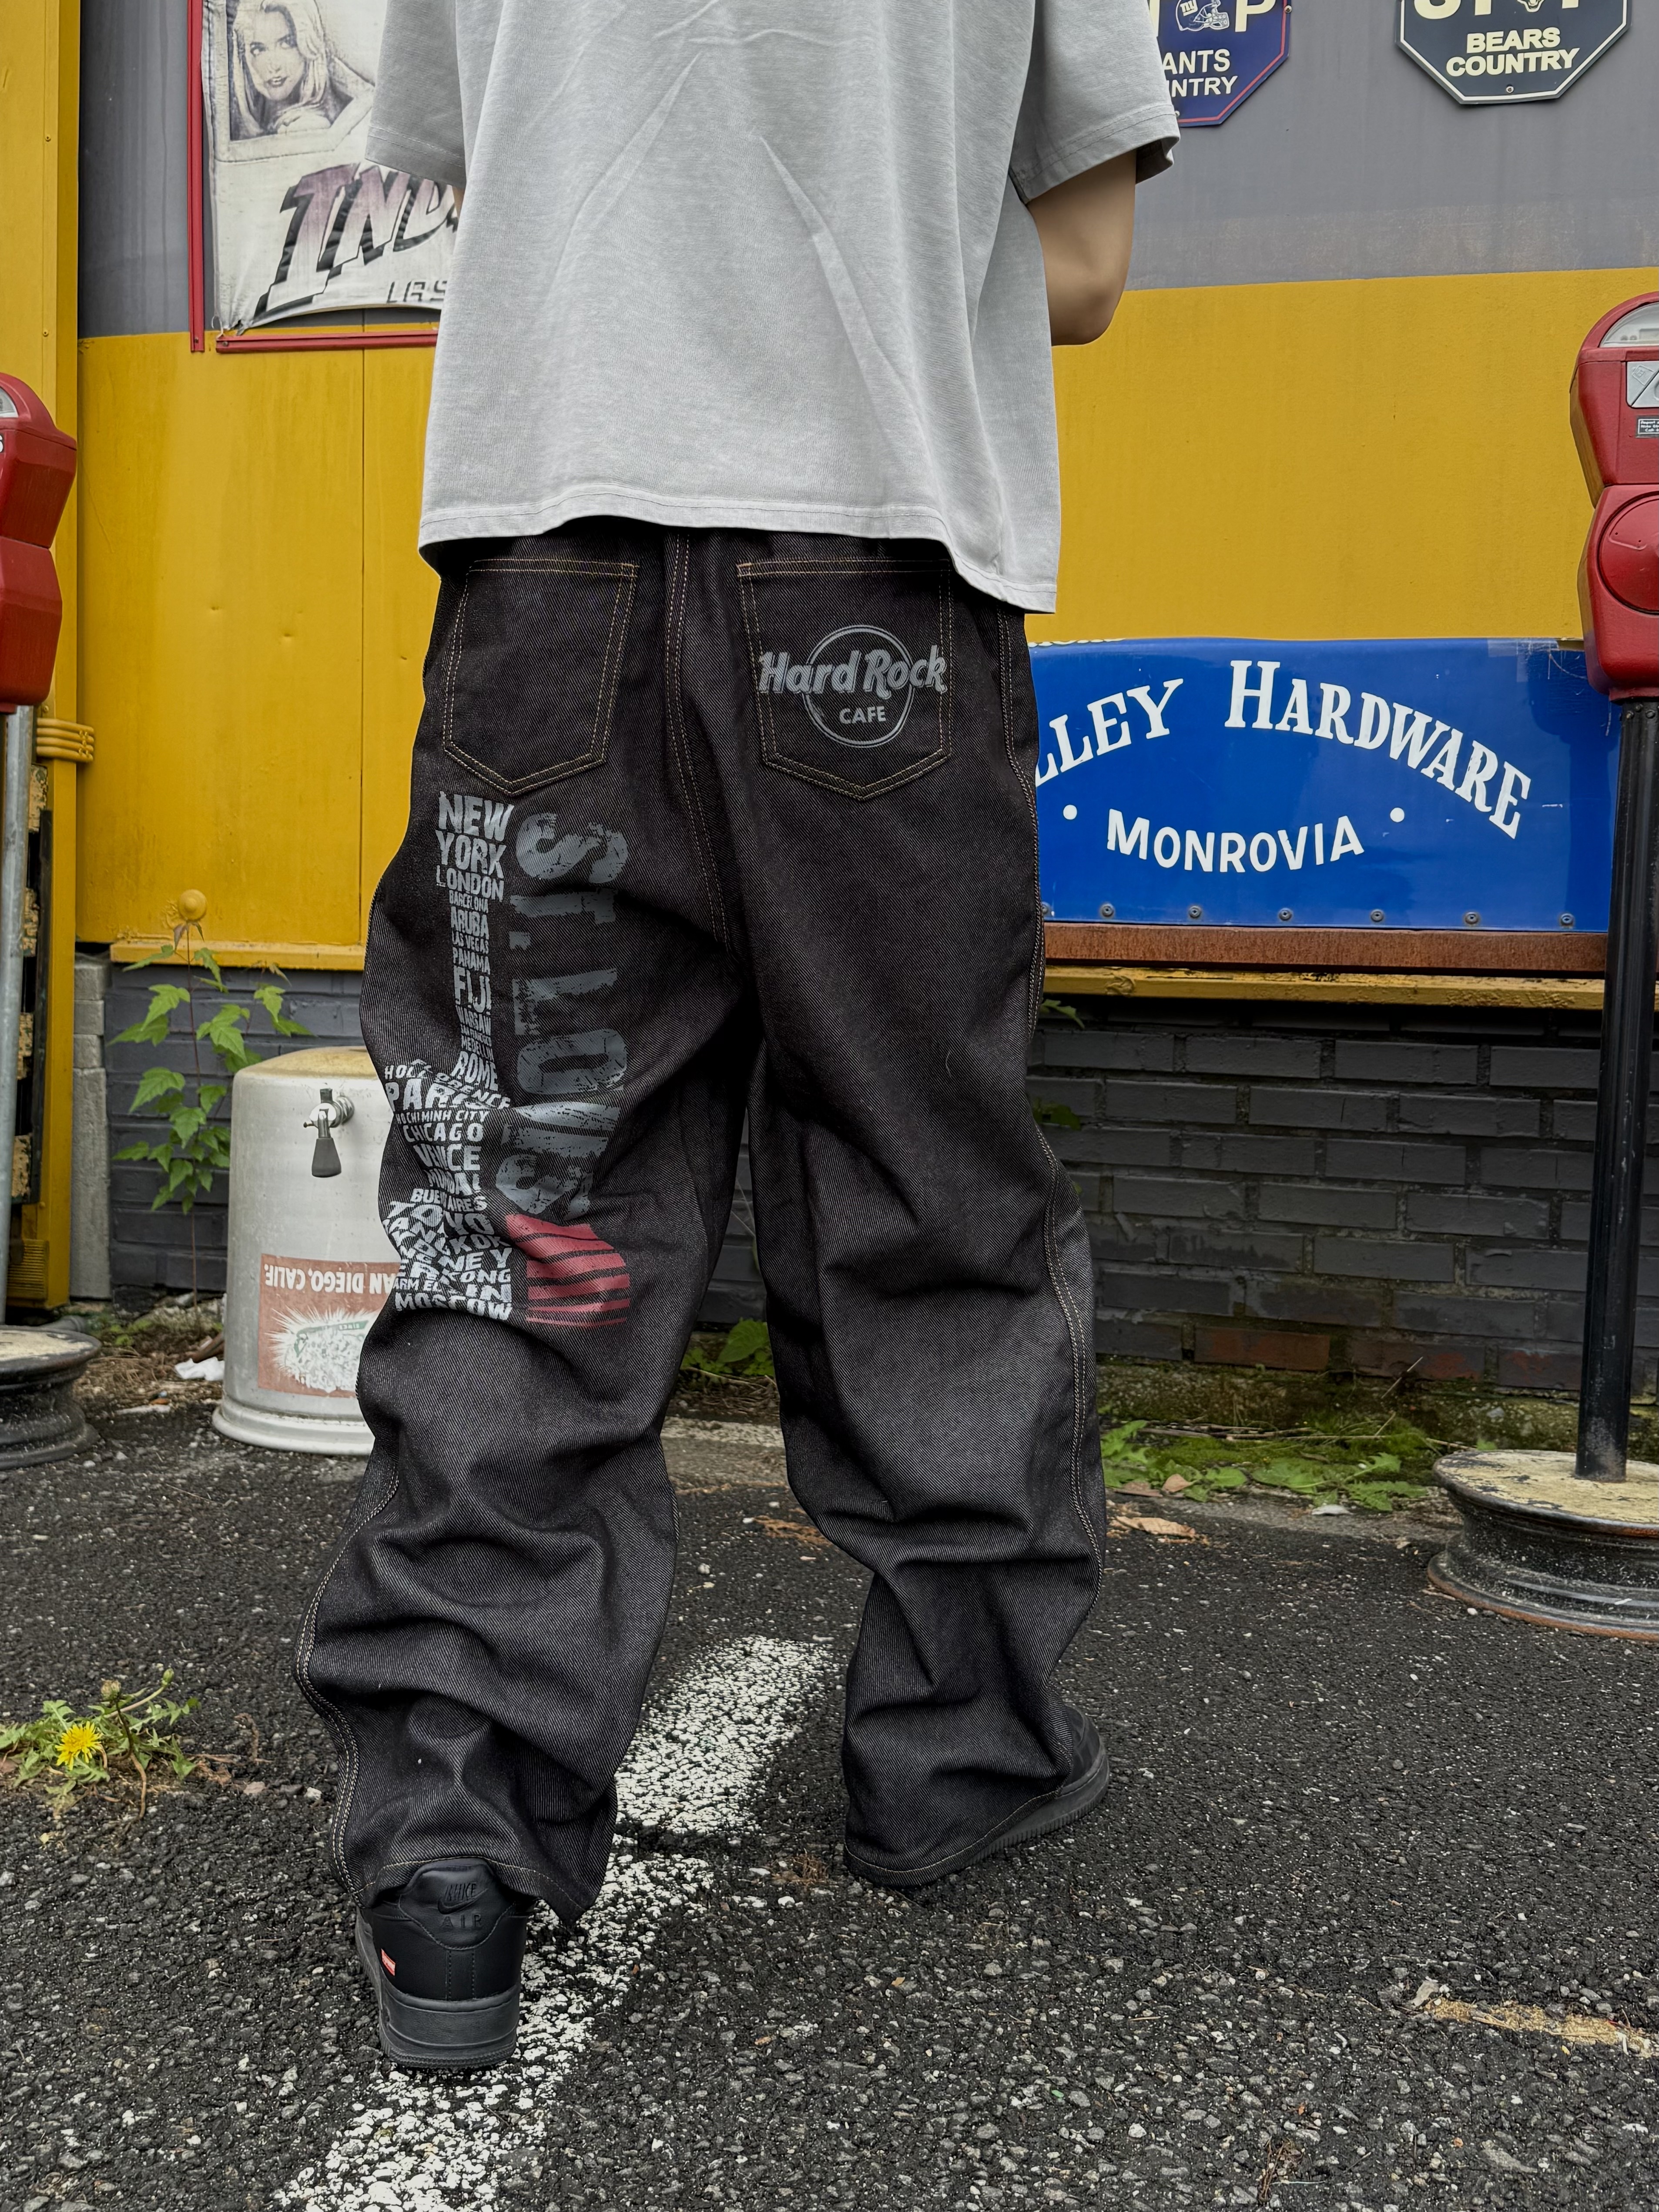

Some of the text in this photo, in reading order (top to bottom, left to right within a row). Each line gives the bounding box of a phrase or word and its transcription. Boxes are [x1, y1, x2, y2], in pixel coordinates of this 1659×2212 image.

[1466, 27, 1561, 54] BEARS
[1446, 48, 1580, 77] COUNTRY
[1166, 75, 1238, 97] NTRY
[253, 162, 459, 320] IND
[759, 644, 948, 699] Hard Rock
[839, 706, 886, 724] CAFE
[1224, 660, 1532, 840] HARDWARE
[438, 791, 515, 841] NEW
[436, 829, 507, 878] YORK
[1107, 808, 1364, 873] MONROVIA
[436, 865, 505, 902] LONDON
[449, 890, 489, 914] BARCELONA
[451, 906, 489, 940] ARUBA
[452, 927, 489, 955] LAS VEGAS
[452, 947, 491, 975] PANAMA
[453, 965, 492, 1016] FIJI
[450, 1051, 499, 1091] ROME
[406, 1112, 420, 1123] CHI
[422, 1110, 452, 1122] MINH
[455, 1110, 489, 1122] CITY
[402, 1122, 484, 1142] CHICAGO
[447, 1195, 487, 1212] AIRES
[386, 1201, 495, 1235] TOYO
[264, 1264, 306, 1290] CALIF.
[308, 1268, 365, 1294] DIEGO,
[440, 1914, 482, 1928] AIR
